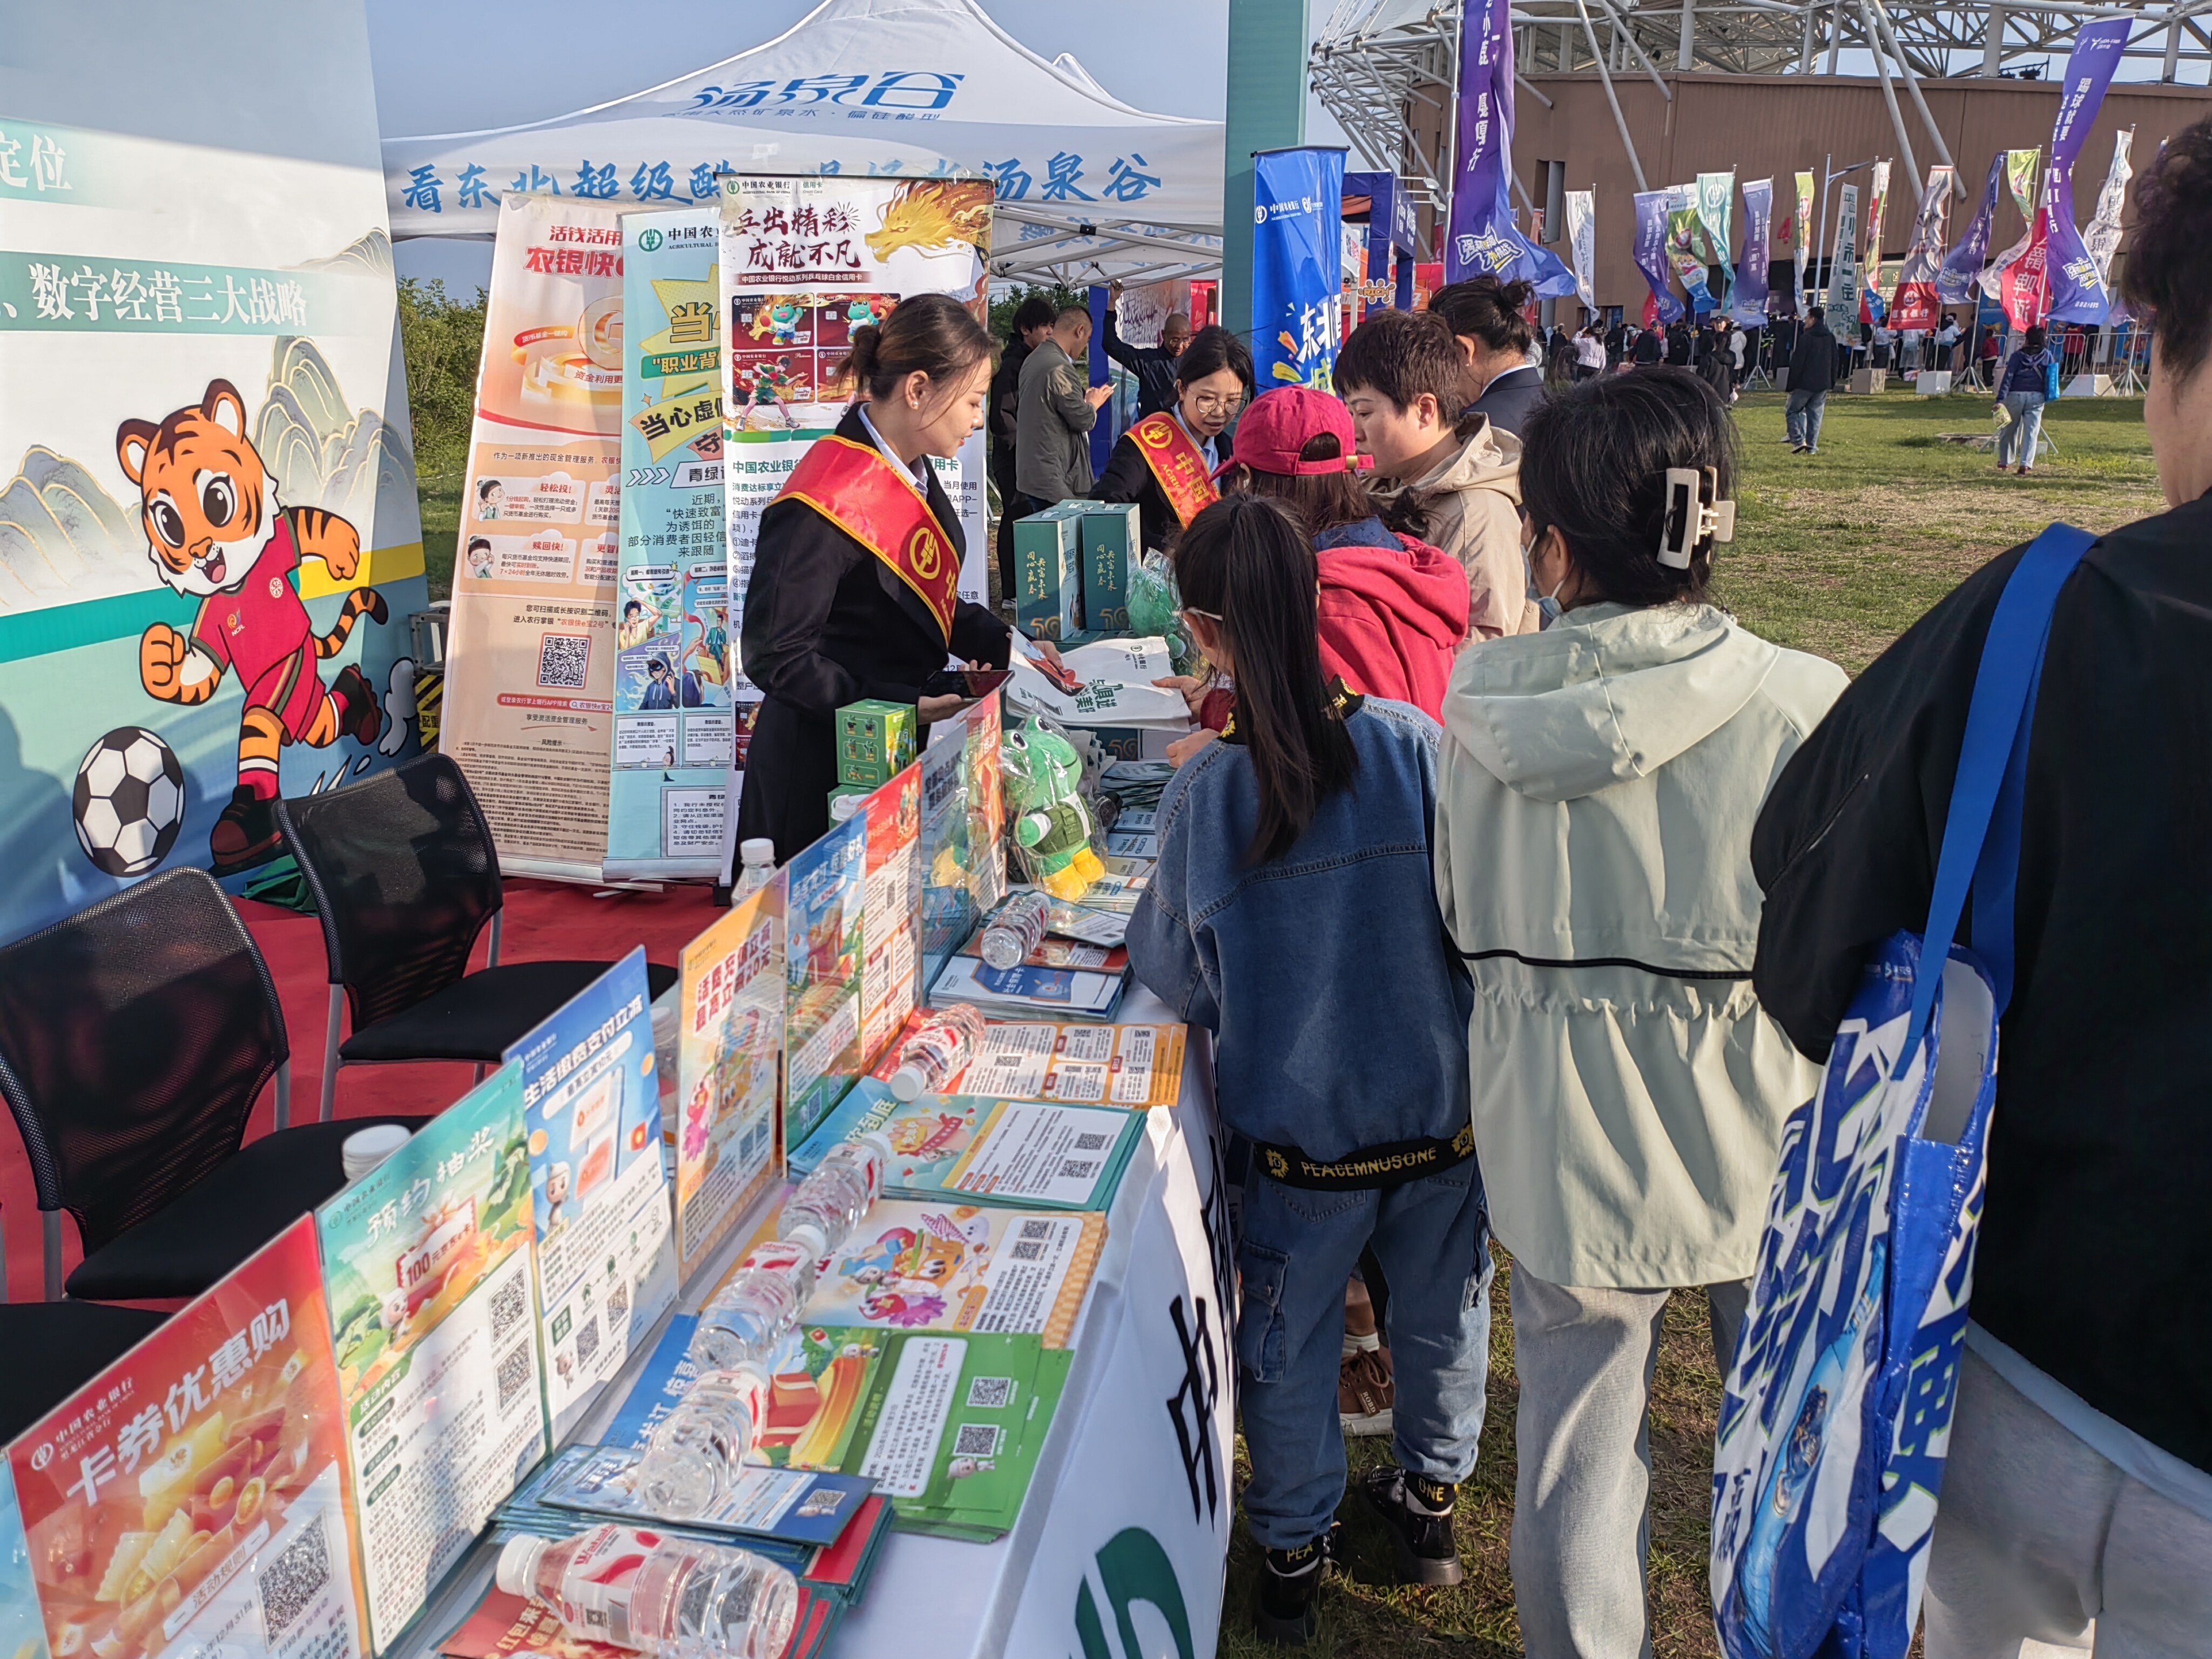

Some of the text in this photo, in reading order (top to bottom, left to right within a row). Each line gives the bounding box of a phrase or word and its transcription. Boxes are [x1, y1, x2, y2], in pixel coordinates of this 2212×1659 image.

[686, 72, 965, 110] 汤泉谷
[0, 131, 73, 191] 定位
[742, 180, 790, 190] 中国农业银行
[549, 226, 622, 245] 活钱活用
[668, 226, 720, 241] 中国农
[742, 273, 862, 283] 中国农业银行悦动系列乒乓球白金信用卡
[1364, 287, 1390, 297] RICH
[670, 302, 720, 343] 当
[695, 430, 724, 453] 守
[689, 465, 724, 482] 青绿
[943, 481, 977, 490] 当月使用
[597, 544, 618, 554] 更智
[67, 1298, 291, 1507] 卡券优惠购
[1418, 1477, 1444, 1502] ONE
[193, 1545, 247, 1608] 活动规则
